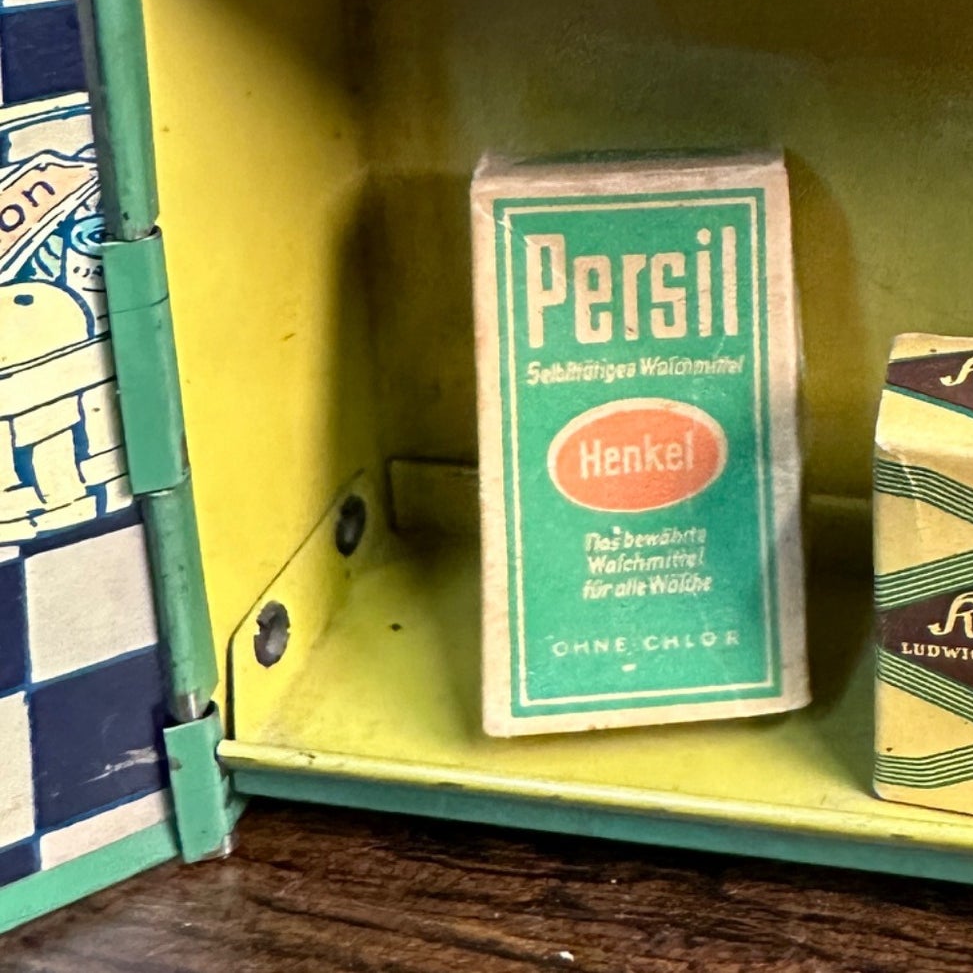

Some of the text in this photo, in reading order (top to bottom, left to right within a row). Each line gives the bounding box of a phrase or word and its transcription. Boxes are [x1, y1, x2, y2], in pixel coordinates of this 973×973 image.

[524, 226, 739, 348] Persil
[579, 430, 695, 481] Henkel
[582, 579, 613, 600] für
[614, 578, 647, 597] alle
[552, 629, 740, 658] OHNE CHLOR
